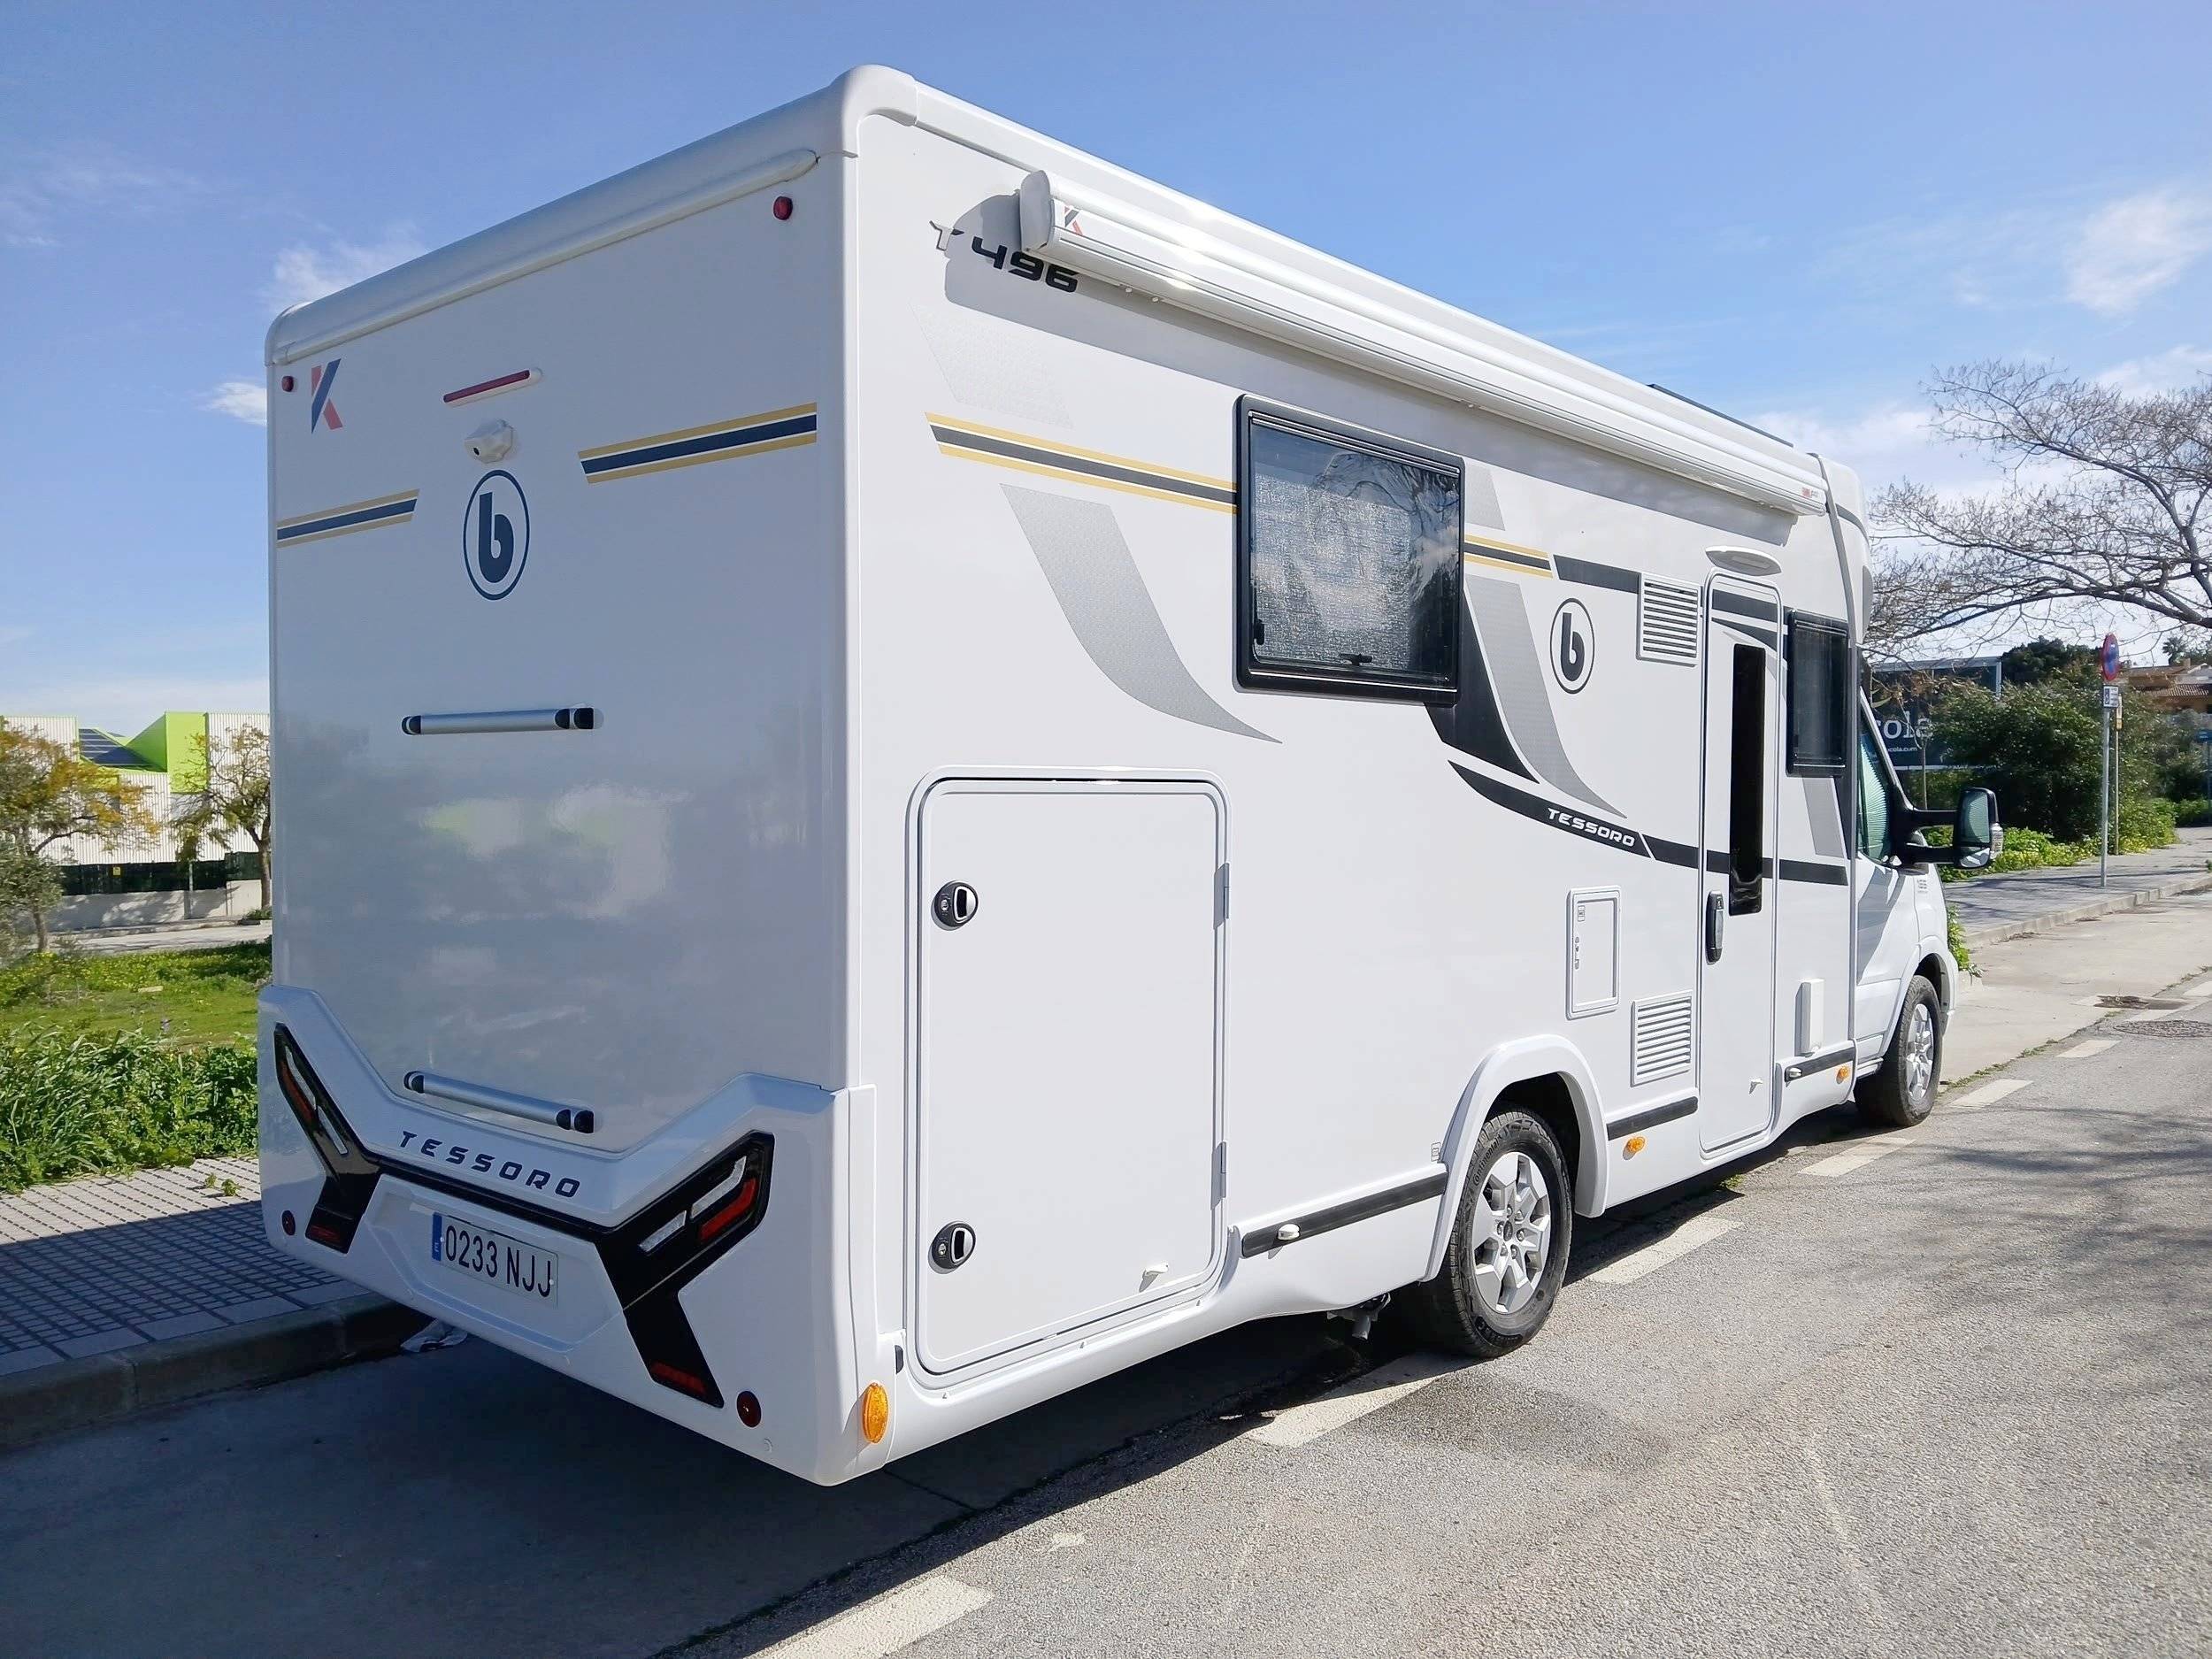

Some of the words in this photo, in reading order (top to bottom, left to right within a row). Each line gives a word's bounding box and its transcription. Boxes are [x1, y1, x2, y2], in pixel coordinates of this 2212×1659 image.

[929, 220, 964, 251] T
[972, 235, 1079, 293] 496
[1875, 710, 1933, 739] ola
[1548, 807, 1635, 847] TESSORO
[400, 1130, 580, 1198] TESSORO
[445, 1225, 498, 1279] 0233
[506, 1246, 552, 1298] NJJ
